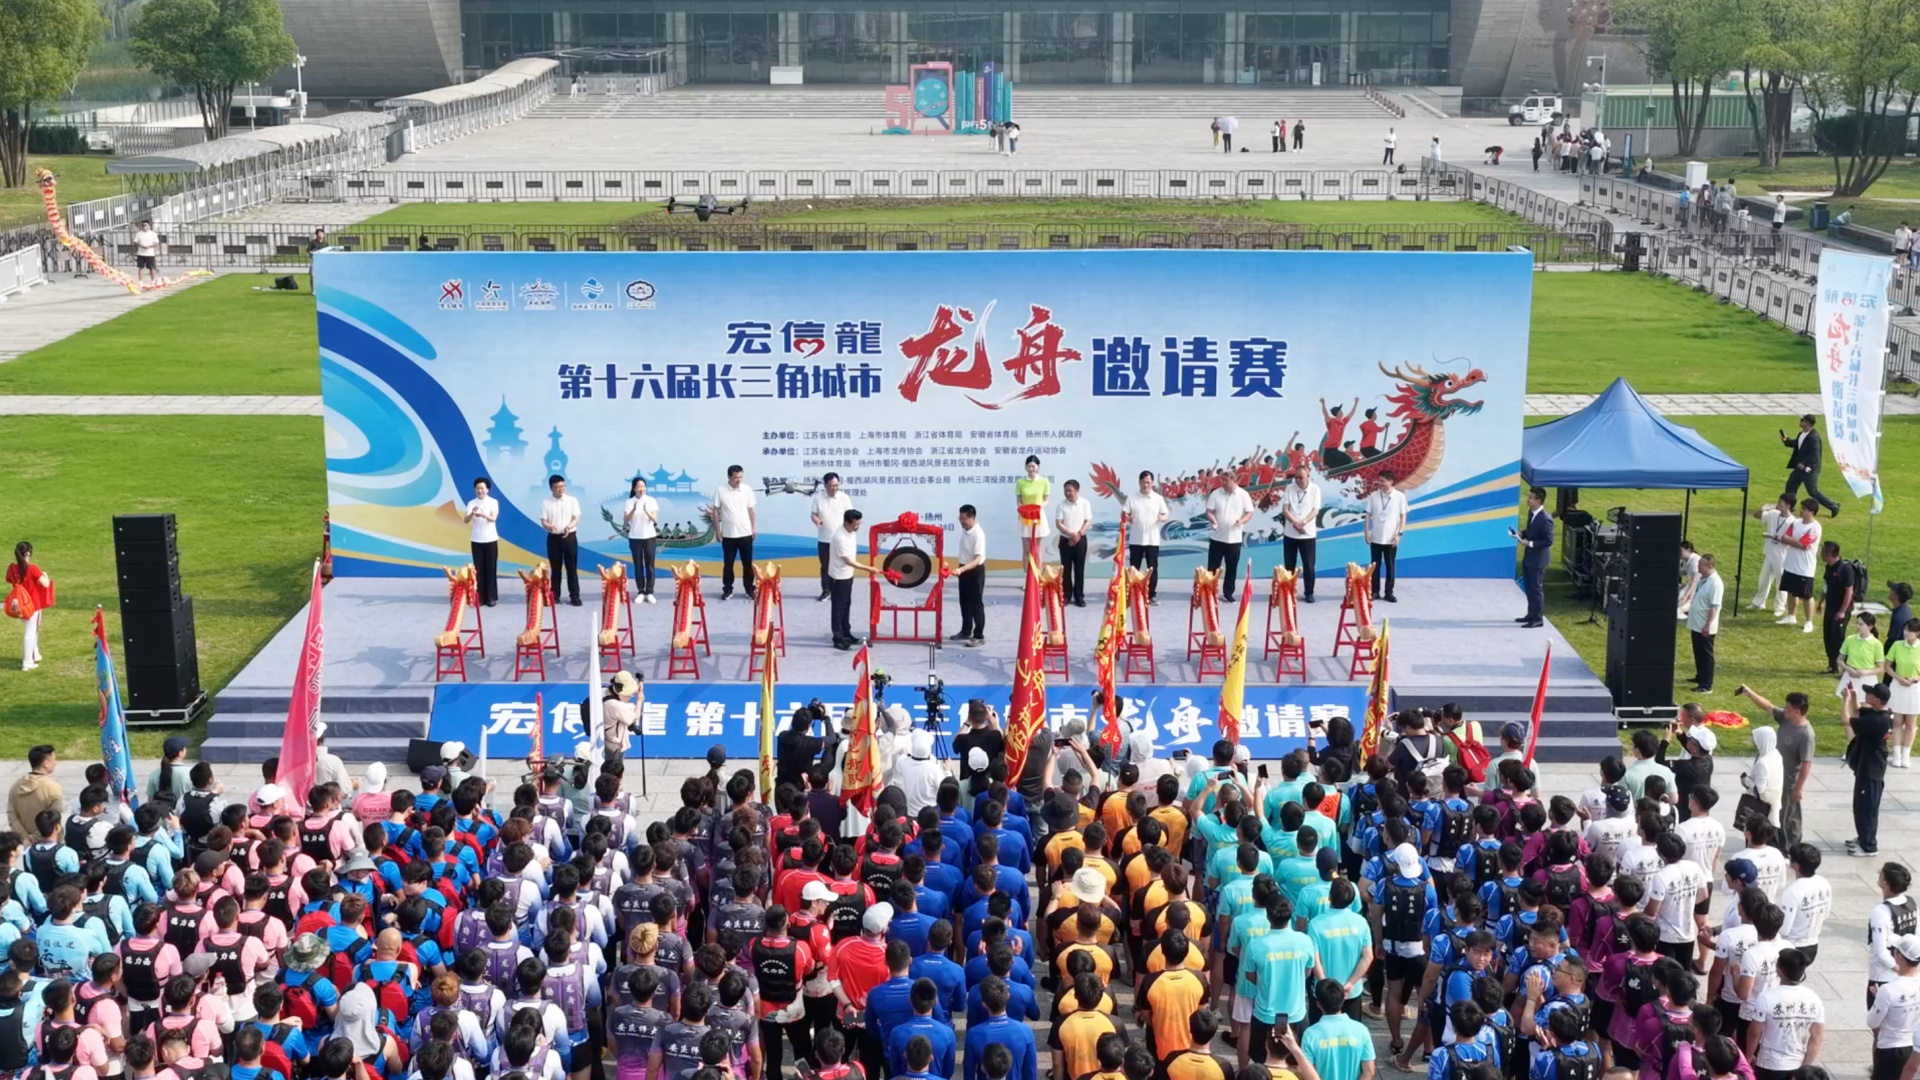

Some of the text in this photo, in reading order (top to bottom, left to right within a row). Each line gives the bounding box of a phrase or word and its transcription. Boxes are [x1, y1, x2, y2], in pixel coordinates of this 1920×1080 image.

[725, 320, 883, 359] 宏信龍
[897, 299, 1082, 410] 龙舟
[557, 362, 883, 400] 第十六届长三角城市
[1091, 336, 1288, 398] 邀请赛
[761, 429, 1083, 440] 主办单位： 江苏省体育局 上海市体育局 浙江省体育局 安徽省体育局 扬州市人民政府
[761, 446, 1067, 456] 承办单位： 江苏省龙舟协会 上海市龙舟协会 浙江省龙舟协会 安徽省龙舟运动协会
[802, 459, 851, 468] 扬州市体育局
